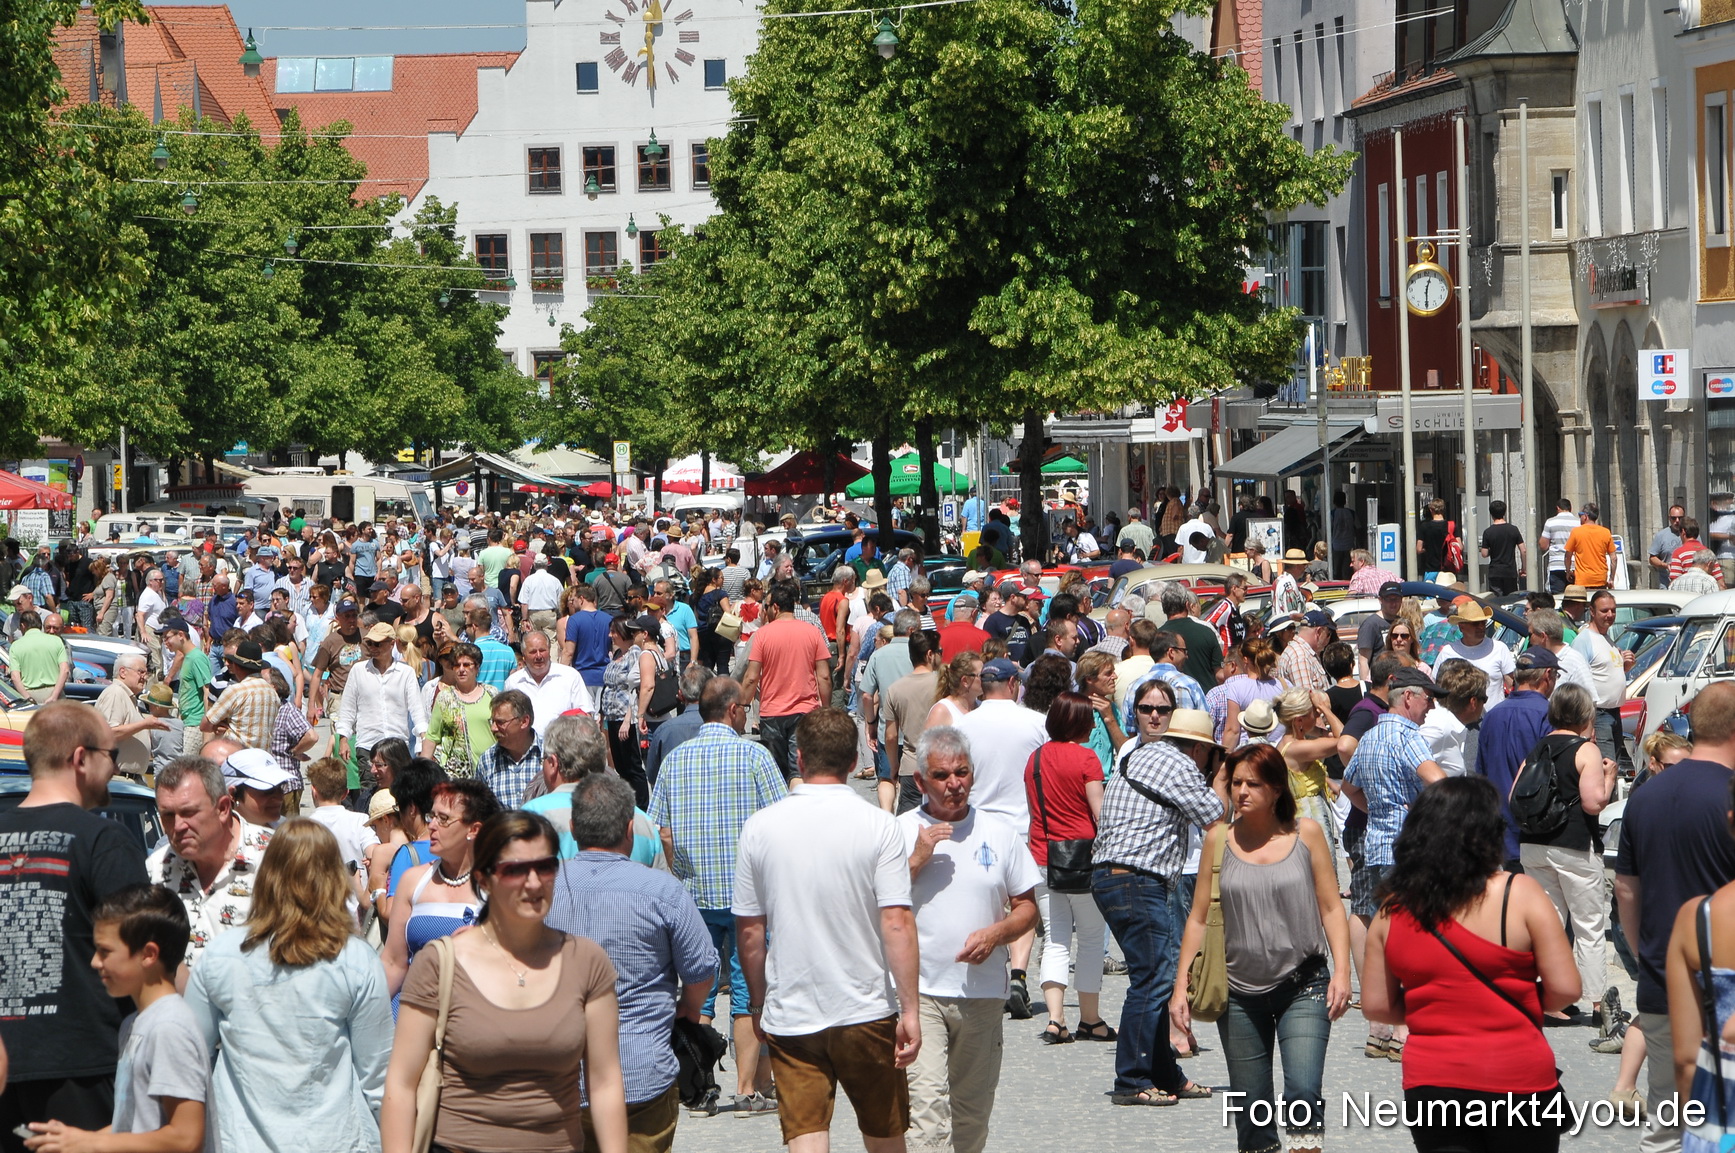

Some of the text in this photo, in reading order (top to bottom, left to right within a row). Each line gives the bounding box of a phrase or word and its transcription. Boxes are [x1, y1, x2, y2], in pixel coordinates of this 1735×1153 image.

[1415, 416, 1484, 429] SCHLIEF
[1384, 535, 1393, 550] P
[0, 830, 76, 847] TALFEST
